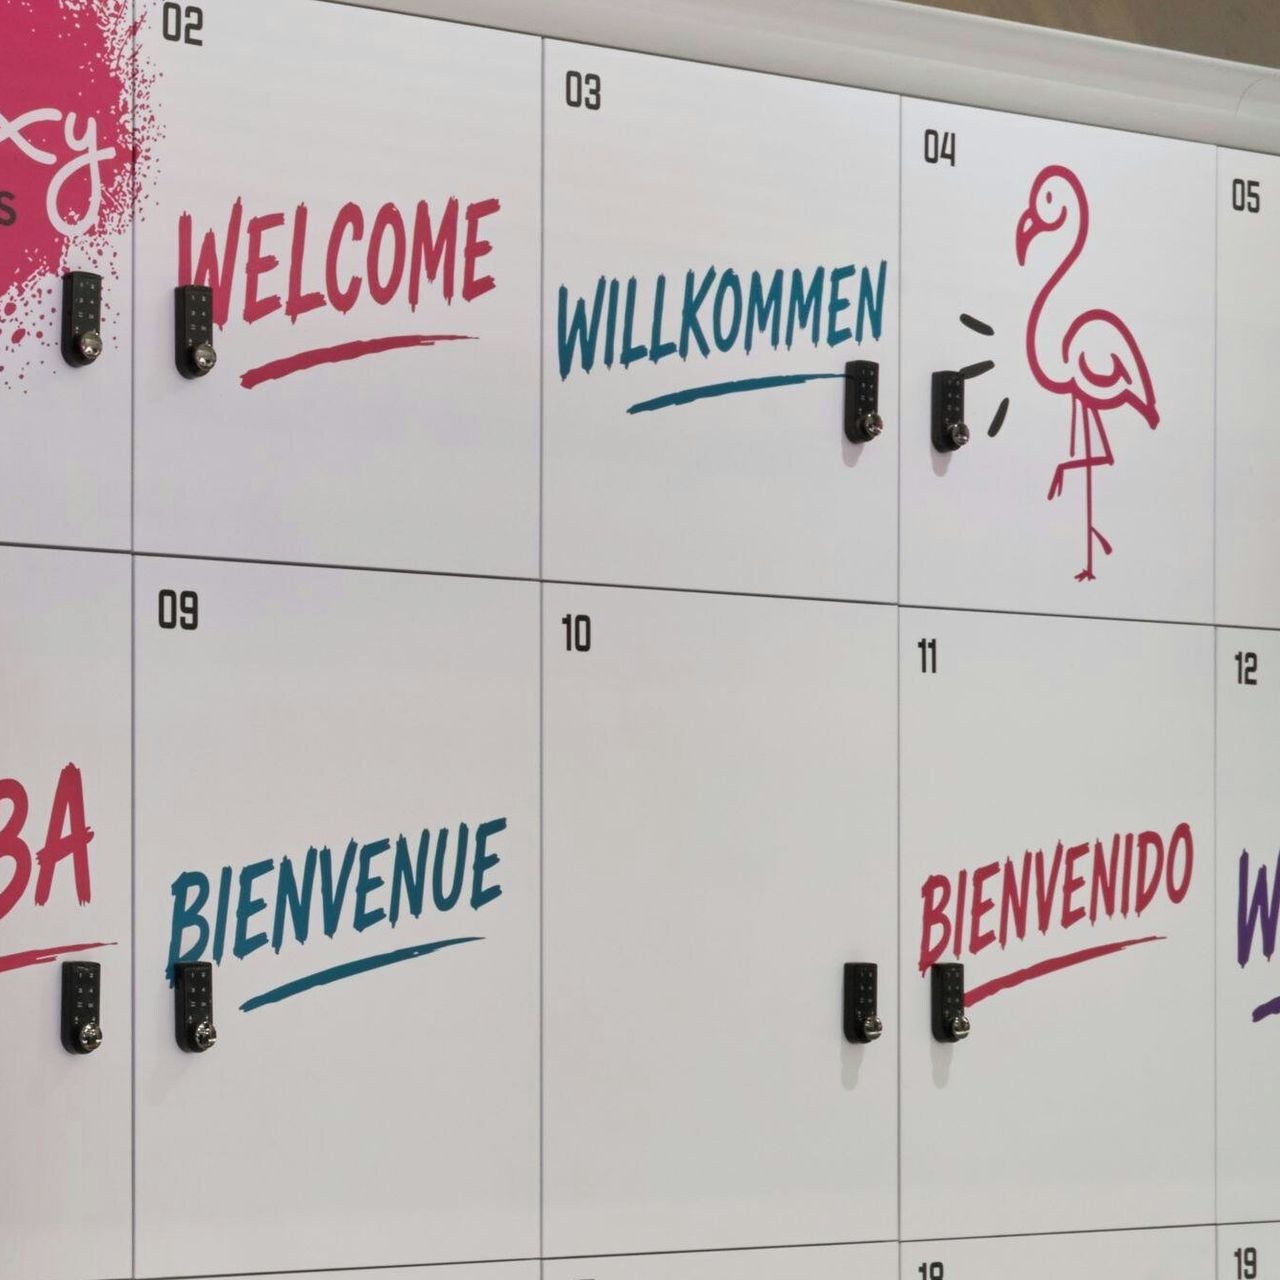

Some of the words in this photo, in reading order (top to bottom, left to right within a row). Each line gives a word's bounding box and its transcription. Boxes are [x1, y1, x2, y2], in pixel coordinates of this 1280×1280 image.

[163, 2, 203, 47] 02
[565, 70, 601, 111] 03
[924, 129, 956, 167] 04
[1231, 178, 1261, 214] 05
[177, 196, 501, 333] WELCOME
[557, 259, 888, 382] WILLKOMMEN
[158, 590, 199, 631] 09
[561, 613, 592, 652] 10
[917, 637, 938, 674] 11
[1235, 652, 1258, 686] 12
[164, 817, 507, 988] BIENVENUE
[918, 822, 1195, 978] BIENVENIDO
[1234, 1247, 1258, 1280] 19
